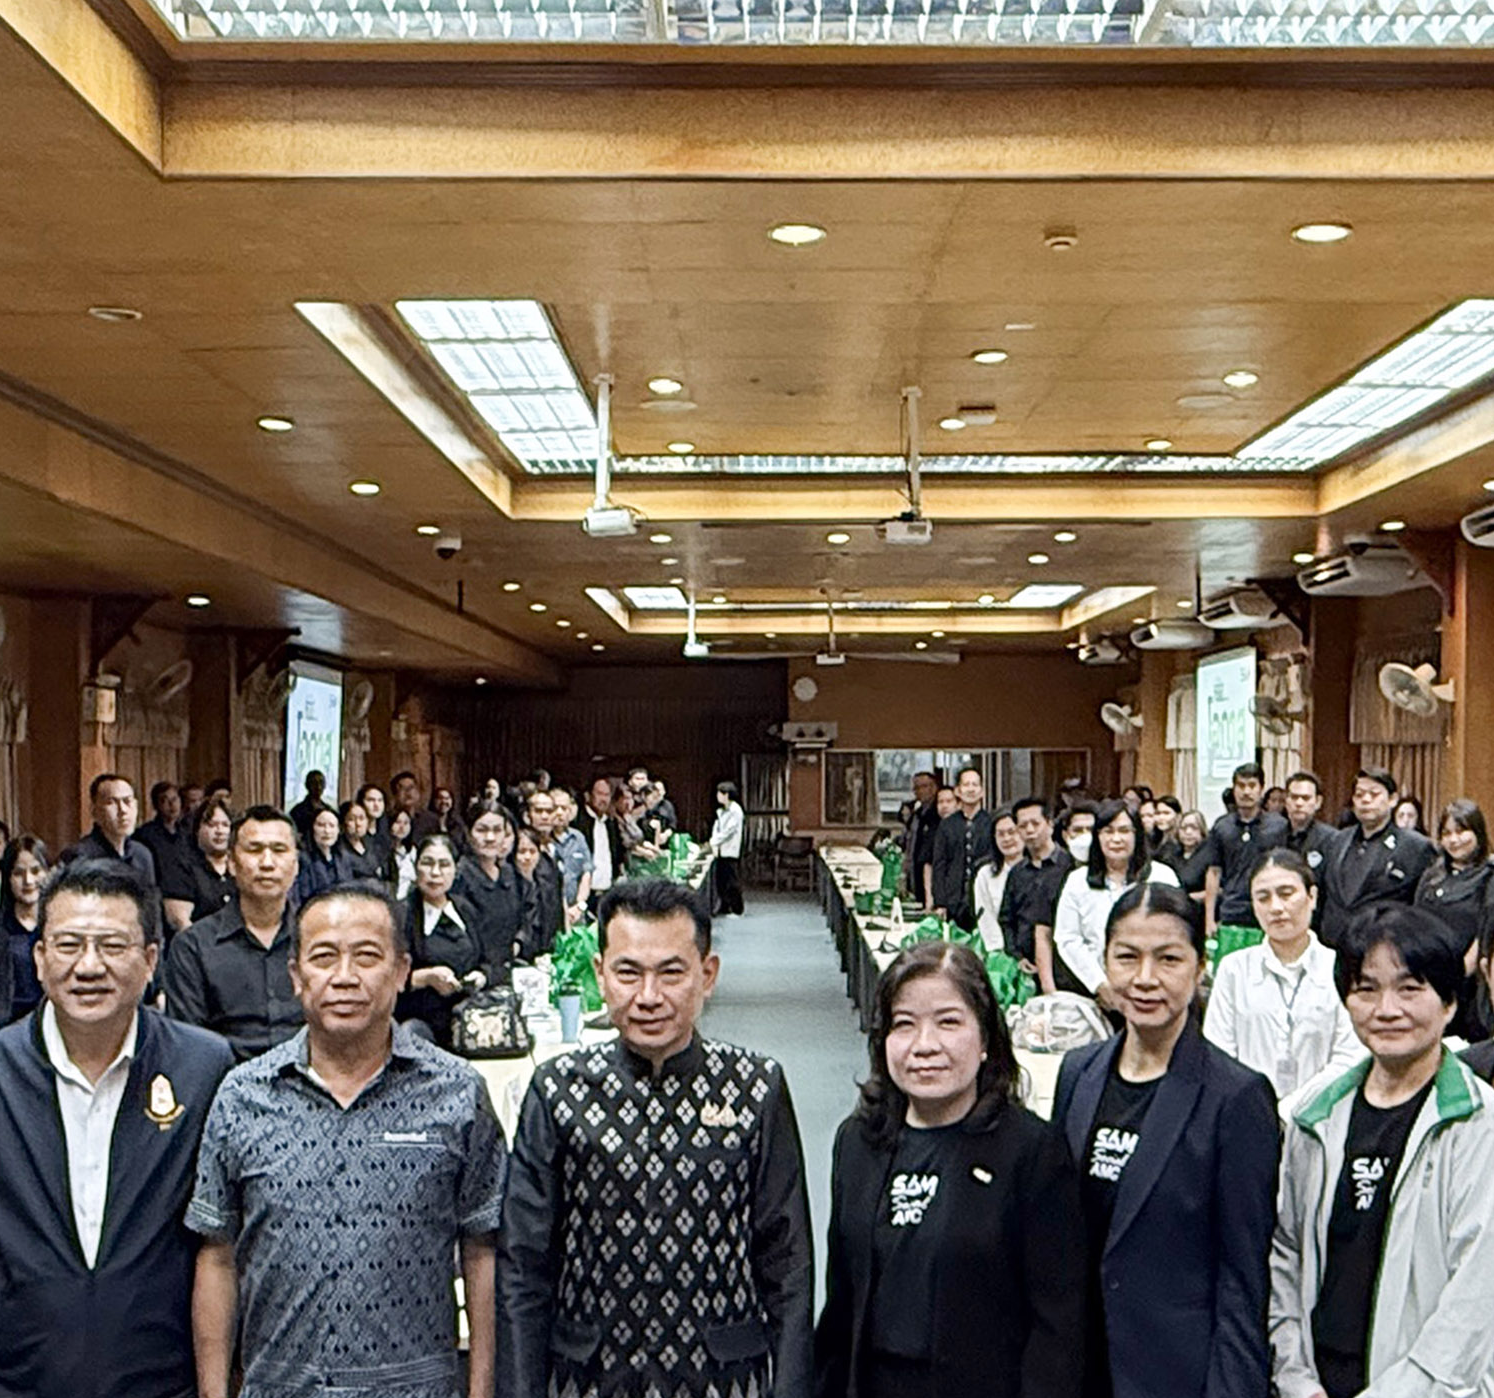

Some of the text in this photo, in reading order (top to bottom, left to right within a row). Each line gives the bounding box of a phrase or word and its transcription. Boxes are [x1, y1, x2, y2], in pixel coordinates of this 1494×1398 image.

[1093, 1127, 1140, 1155] SAM
[1352, 1156, 1390, 1180] SA
[891, 1174, 939, 1197] SAM
